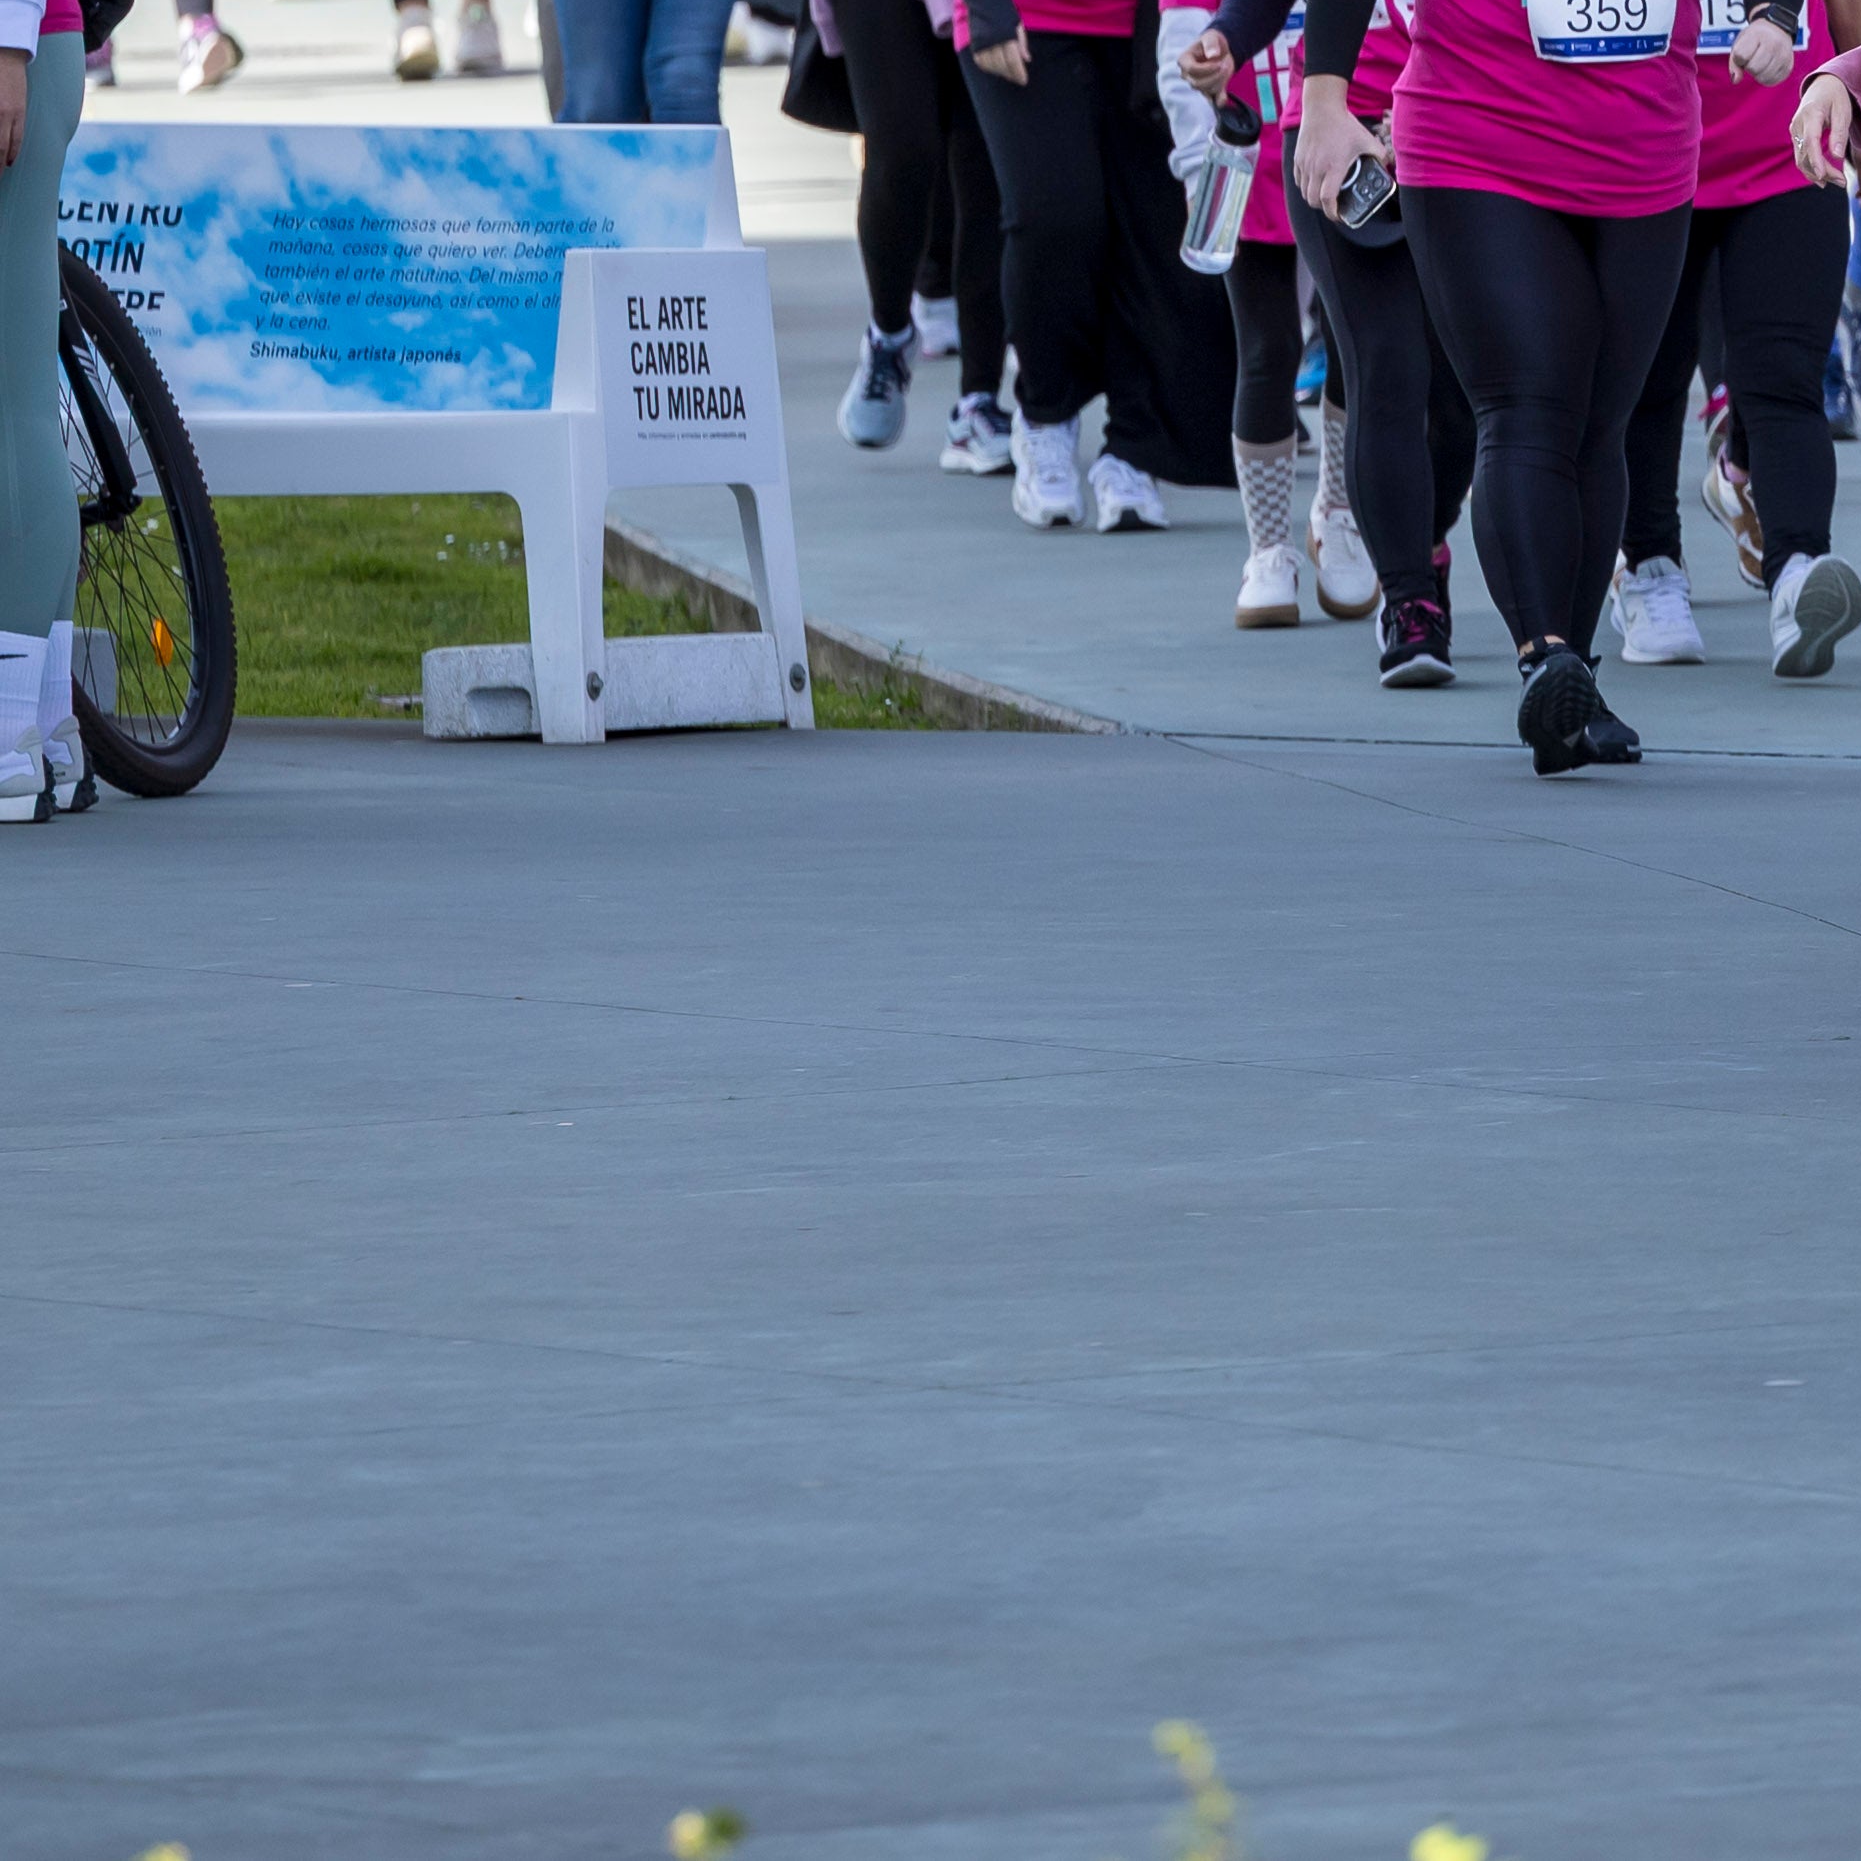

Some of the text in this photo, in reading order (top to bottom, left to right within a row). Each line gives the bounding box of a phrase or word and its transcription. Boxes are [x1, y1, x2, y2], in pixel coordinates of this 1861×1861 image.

[273, 212, 615, 237] Hay cosas hermosas que forman parte de la
[268, 239, 336, 256] mañana,
[342, 243, 388, 256] cosas
[393, 244, 423, 259] que
[428, 242, 477, 260] quiero
[483, 246, 508, 259] ver.
[265, 264, 330, 280] también
[335, 266, 349, 280] el
[353, 268, 385, 281] arte
[390, 266, 463, 283] matutino.
[469, 266, 495, 284] Del
[499, 269, 548, 284] mismo
[259, 290, 290, 306] que
[295, 290, 341, 306] existe
[346, 290, 361, 306] el
[365, 291, 443, 310] desayuno,
[450, 292, 472, 308] así
[477, 296, 519, 309] como
[525, 292, 538, 309] el
[255, 313, 331, 331] y la cena.
[627, 296, 708, 330] EL ARTE
[250, 341, 461, 366] Shimabuku, artista japonés
[631, 341, 711, 375] CAMBIA
[633, 386, 747, 421] TU MIRADA
